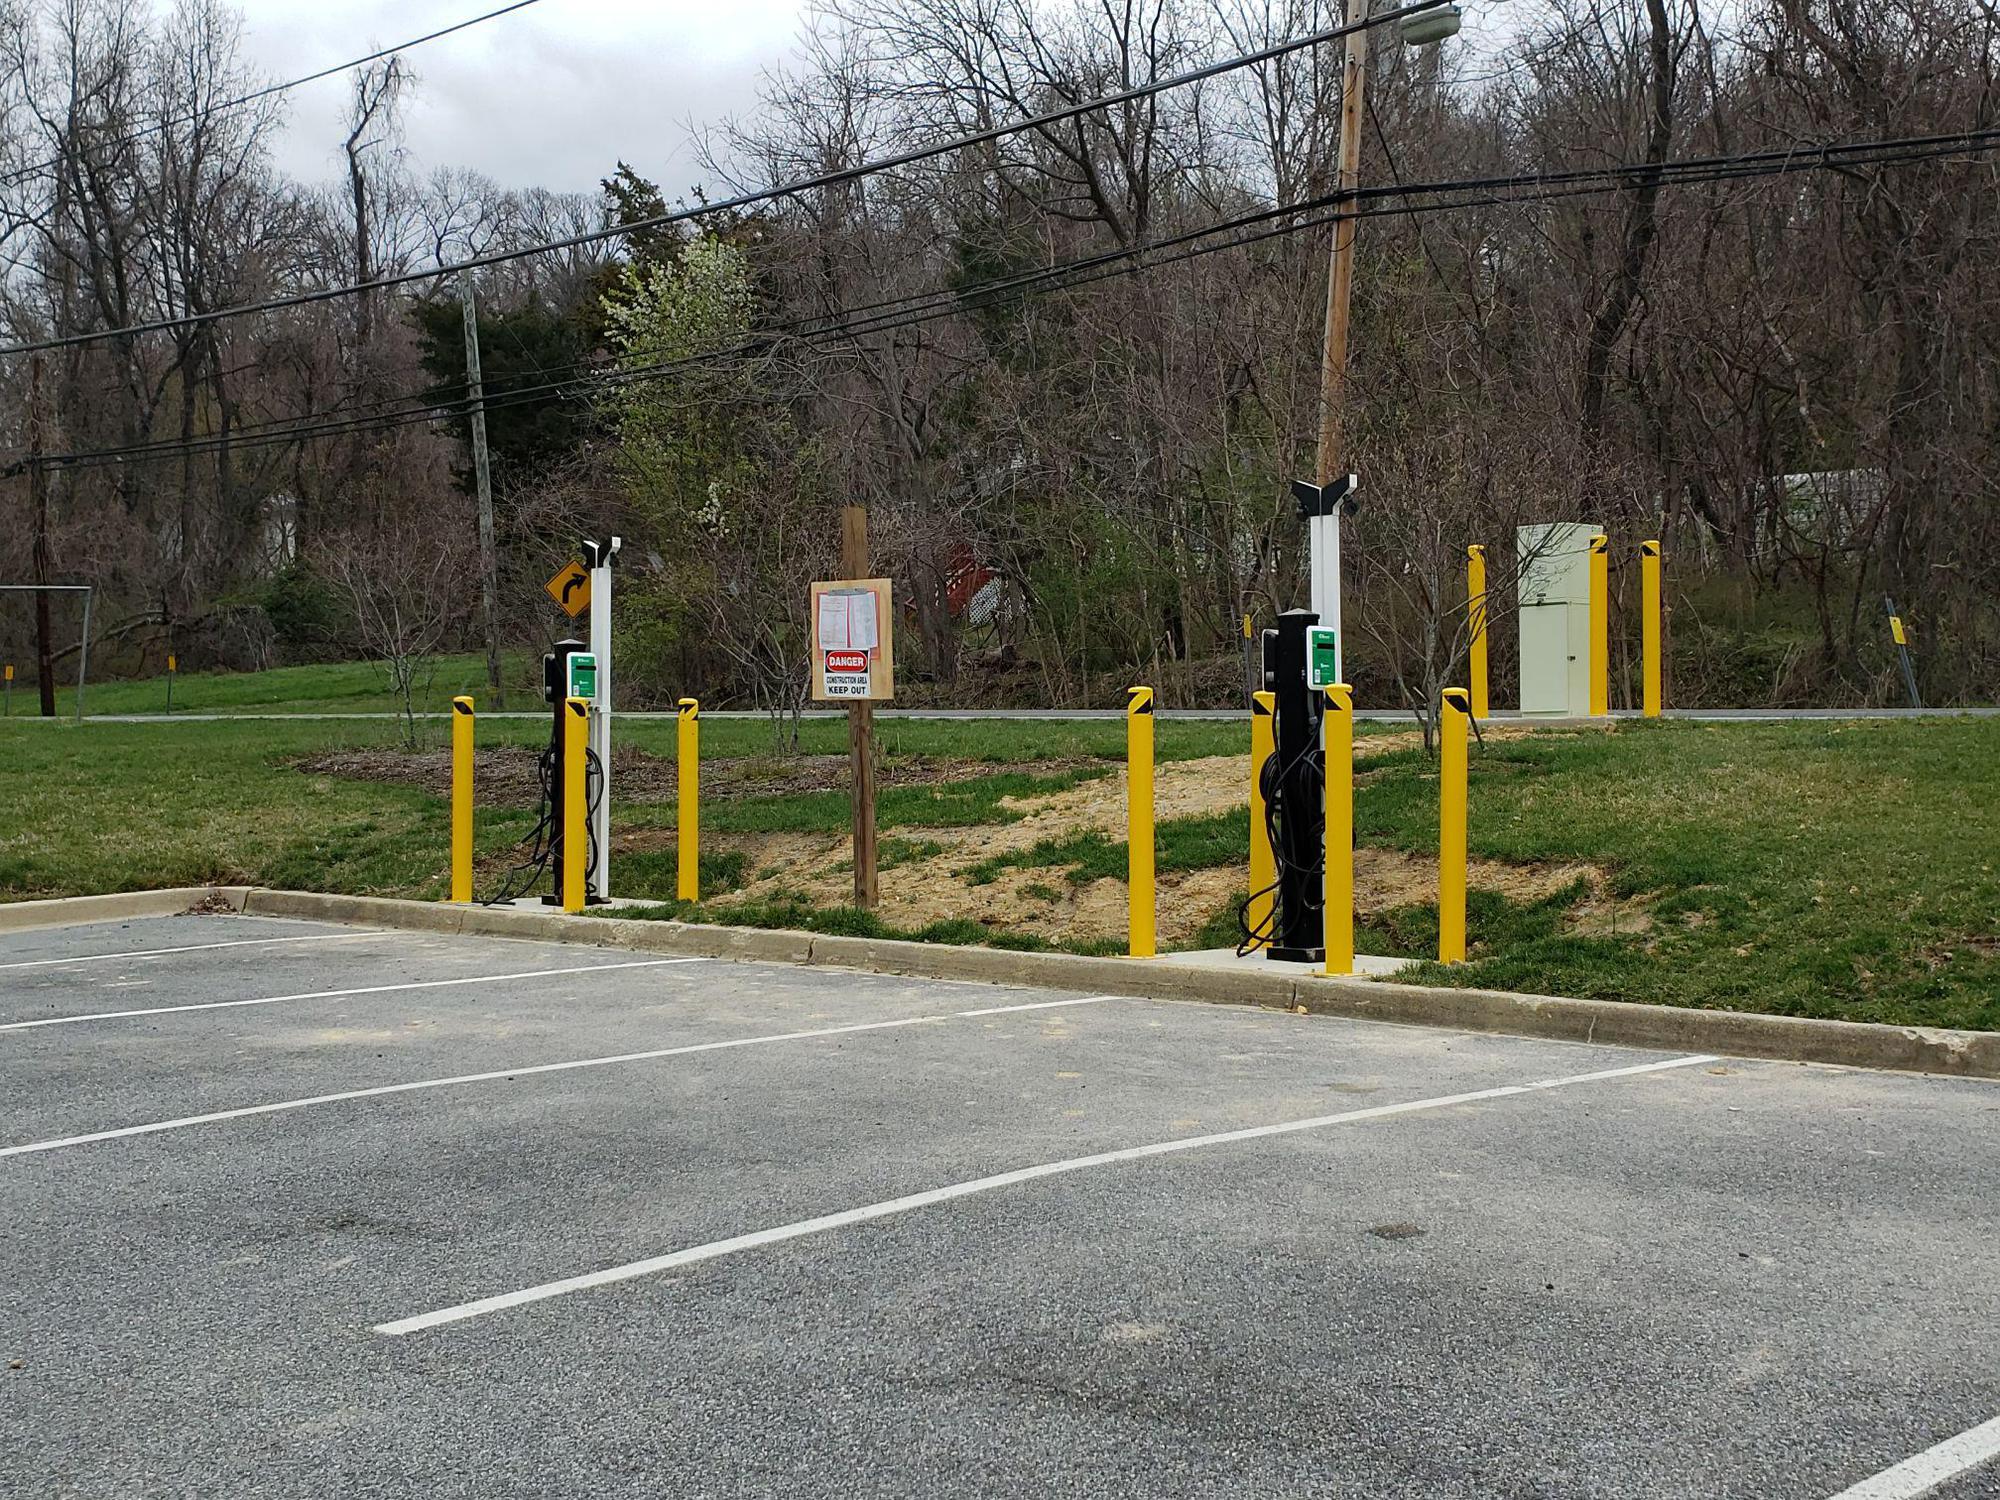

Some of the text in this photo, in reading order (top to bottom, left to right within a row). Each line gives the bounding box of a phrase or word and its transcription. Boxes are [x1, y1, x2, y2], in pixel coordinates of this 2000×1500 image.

[829, 656, 864, 667] DANGER
[826, 676, 868, 684] CONSTRUCTION AREA
[828, 686, 866, 694] KEEP OUT
